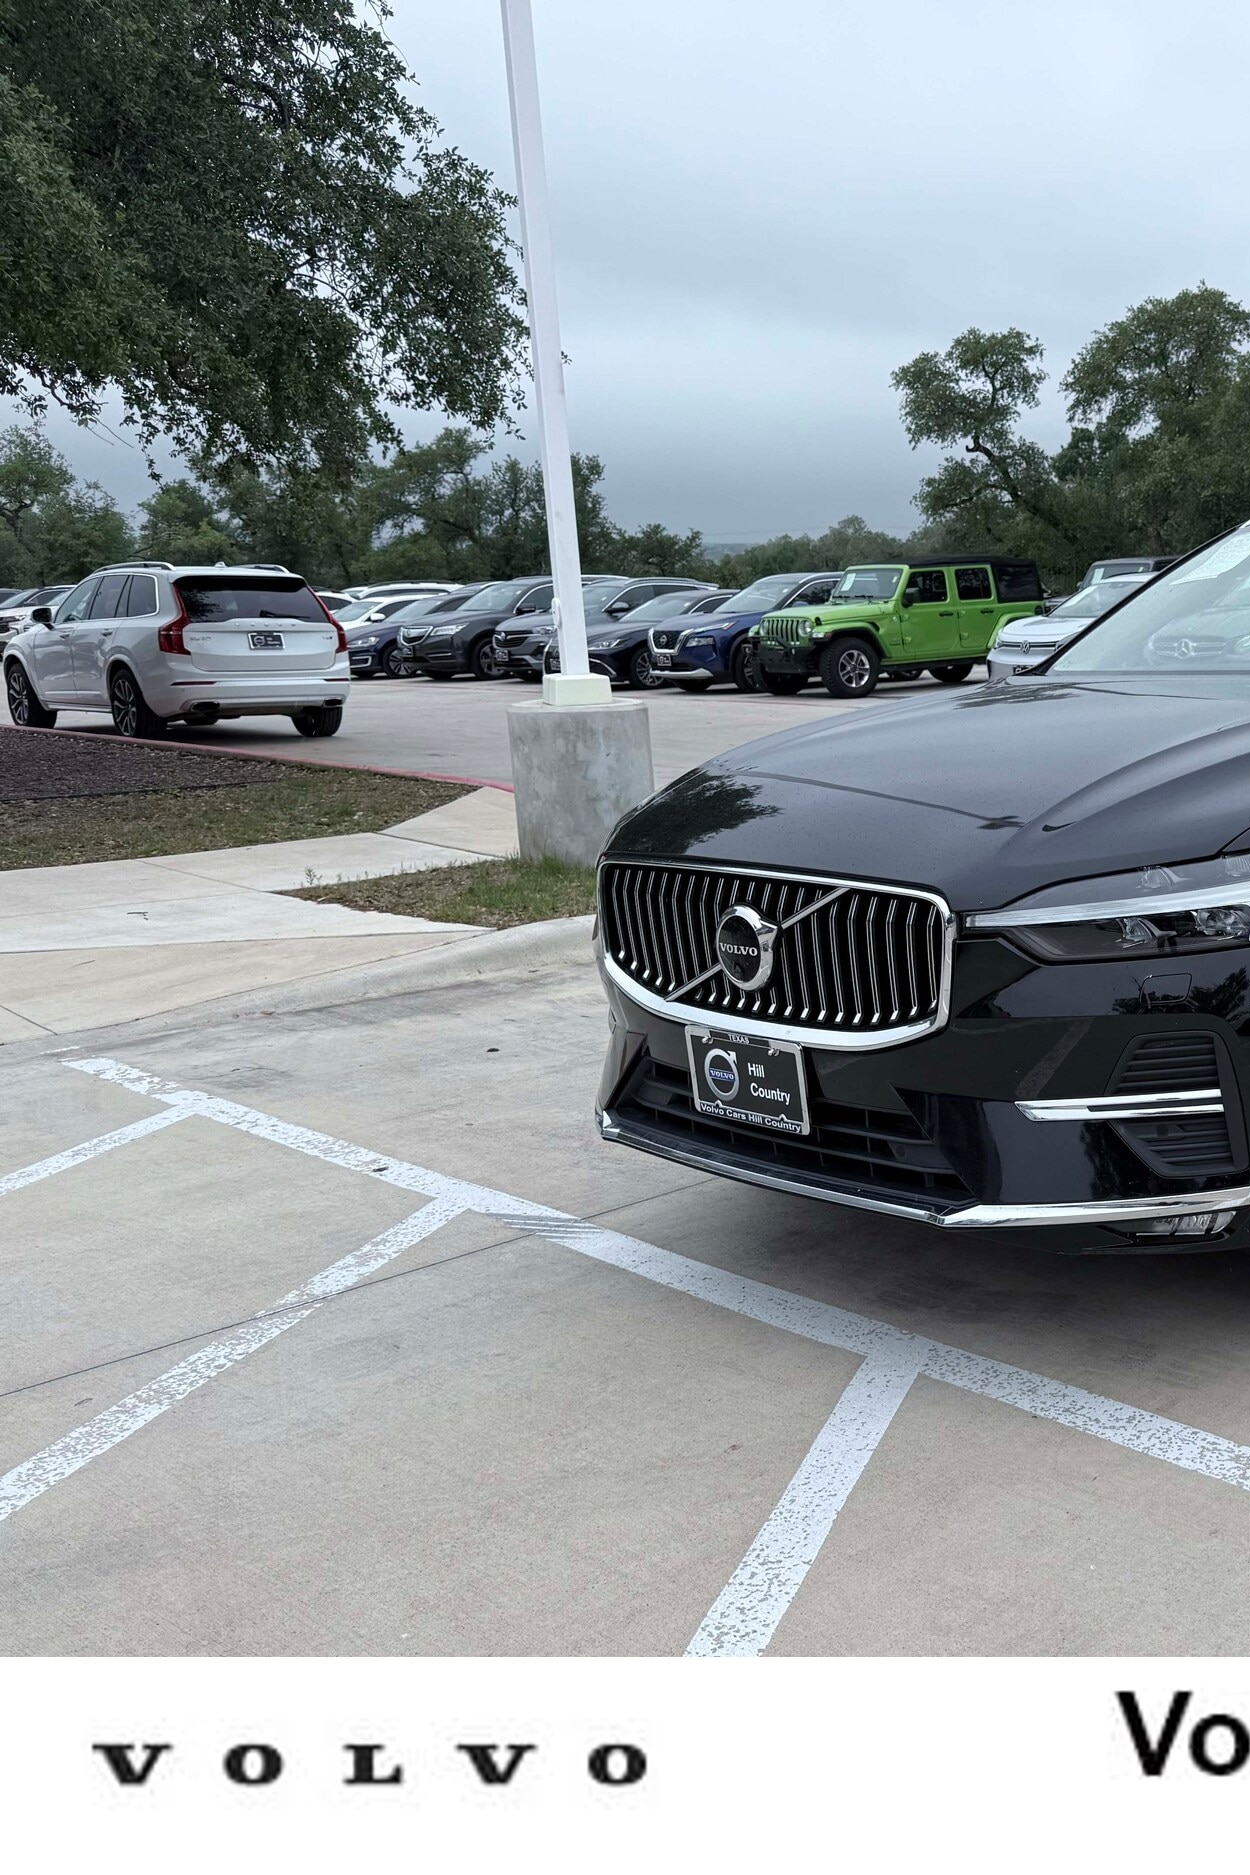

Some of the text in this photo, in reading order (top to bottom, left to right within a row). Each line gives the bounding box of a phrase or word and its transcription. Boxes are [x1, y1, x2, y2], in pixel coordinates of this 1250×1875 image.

[719, 942, 758, 957] VOLVO
[727, 1034, 750, 1044] TEXAS
[710, 1069, 735, 1080] VOLVO
[747, 1062, 765, 1079] Hill
[750, 1082, 791, 1106] Country
[700, 1102, 801, 1133] Volvo Cars Hill Country
